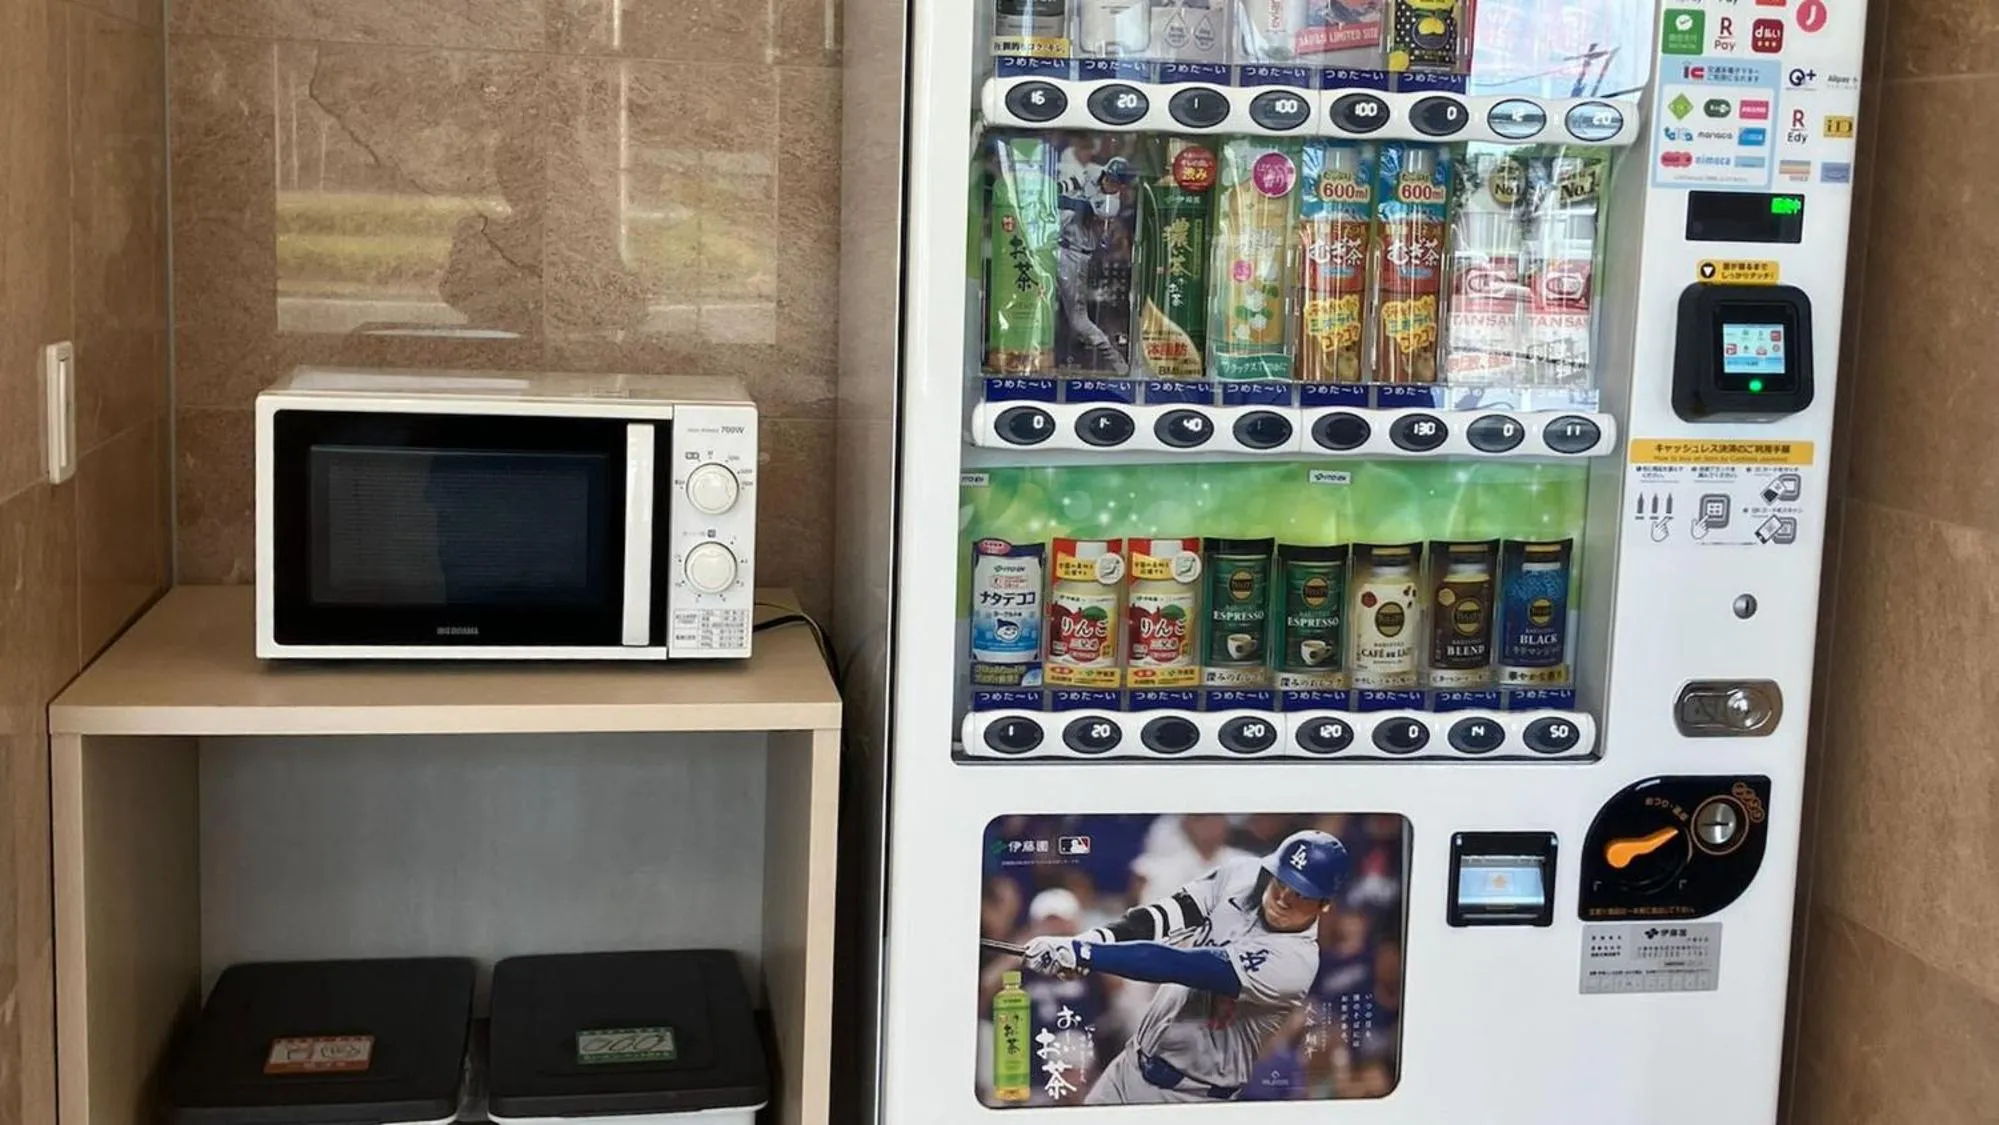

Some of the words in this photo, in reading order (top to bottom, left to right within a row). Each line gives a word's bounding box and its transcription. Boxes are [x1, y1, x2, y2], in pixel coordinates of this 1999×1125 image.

[1714, 40, 1736, 51] Pay
[1030, 91, 1046, 105] 16
[1116, 94, 1138, 108] 20
[1274, 100, 1299, 114] 100
[1354, 102, 1378, 117] 100
[1446, 106, 1458, 120] 0
[1787, 131, 1808, 145] Edy
[1308, 237, 1364, 266] むぎ茶
[1386, 238, 1440, 266] むぎ茶
[1032, 415, 1044, 429] 0
[1413, 422, 1436, 435] 130
[1503, 424, 1514, 436] 0
[980, 590, 1037, 607] ナタデココ
[1212, 609, 1264, 621] ESPRESSO
[1287, 616, 1340, 628] ESPRESSO
[1060, 616, 1108, 638] りんご
[1140, 616, 1185, 638] りんご
[1519, 634, 1558, 645] BLACK
[1446, 645, 1486, 657] BLEND
[1091, 724, 1111, 737] 20
[1242, 723, 1265, 737] 120
[1319, 723, 1342, 737] 120
[1408, 725, 1419, 738] 0
[1008, 839, 1049, 853] 伊藤園
[1035, 1027, 1078, 1101] お茶
